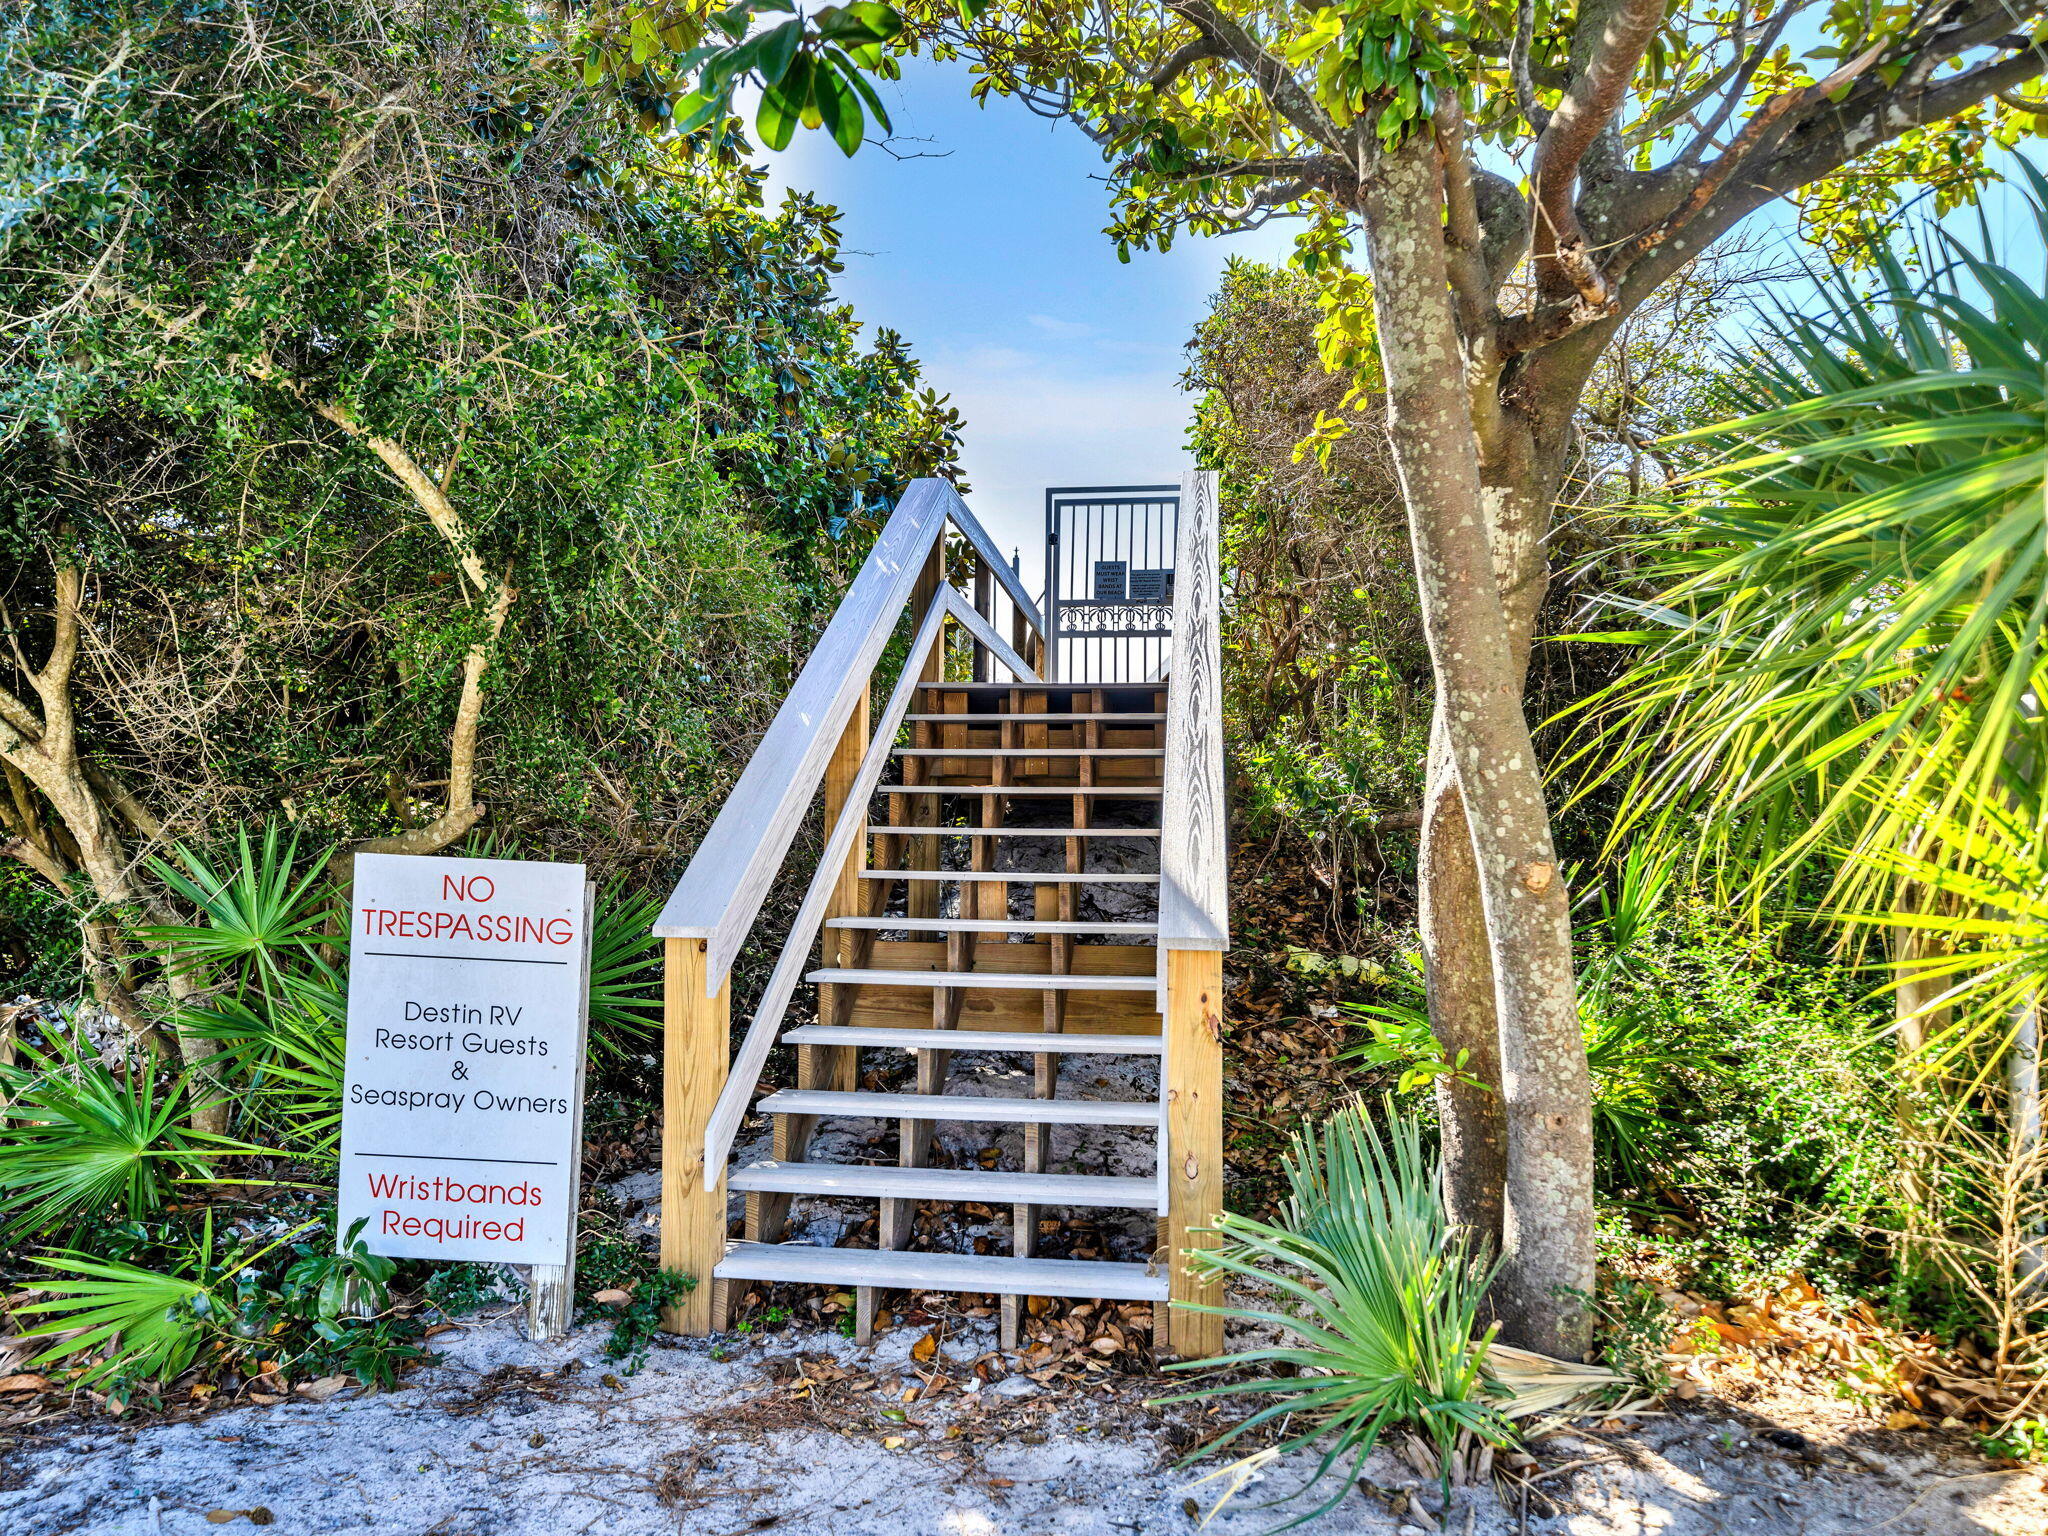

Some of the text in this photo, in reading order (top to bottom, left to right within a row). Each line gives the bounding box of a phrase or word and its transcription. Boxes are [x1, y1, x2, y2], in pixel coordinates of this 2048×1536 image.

[444, 875, 495, 903] NO
[362, 908, 573, 945] TRESPASSING
[405, 1001, 522, 1027] Destin RV
[376, 1029, 548, 1056] Resort Guests
[451, 1061, 469, 1081] &
[351, 1084, 567, 1114] Seaspray Owners
[368, 1173, 542, 1206] Wristbands
[382, 1211, 524, 1243] Required
